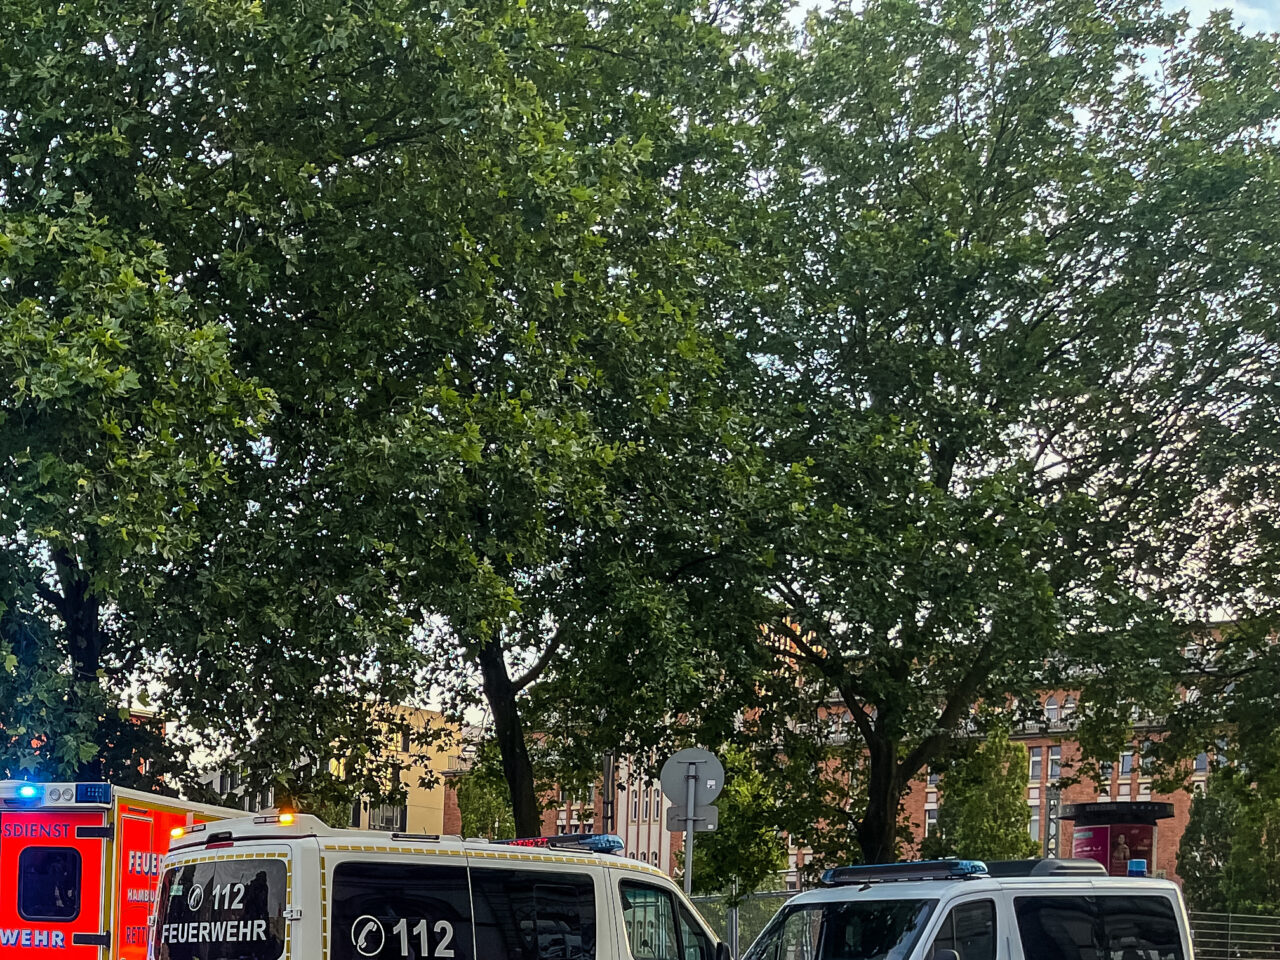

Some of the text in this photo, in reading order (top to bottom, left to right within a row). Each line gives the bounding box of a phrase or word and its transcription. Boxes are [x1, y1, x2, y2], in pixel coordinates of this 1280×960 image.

[212, 883, 245, 910] 112
[161, 919, 267, 944] FEUERWEHR
[392, 918, 455, 958] 112
